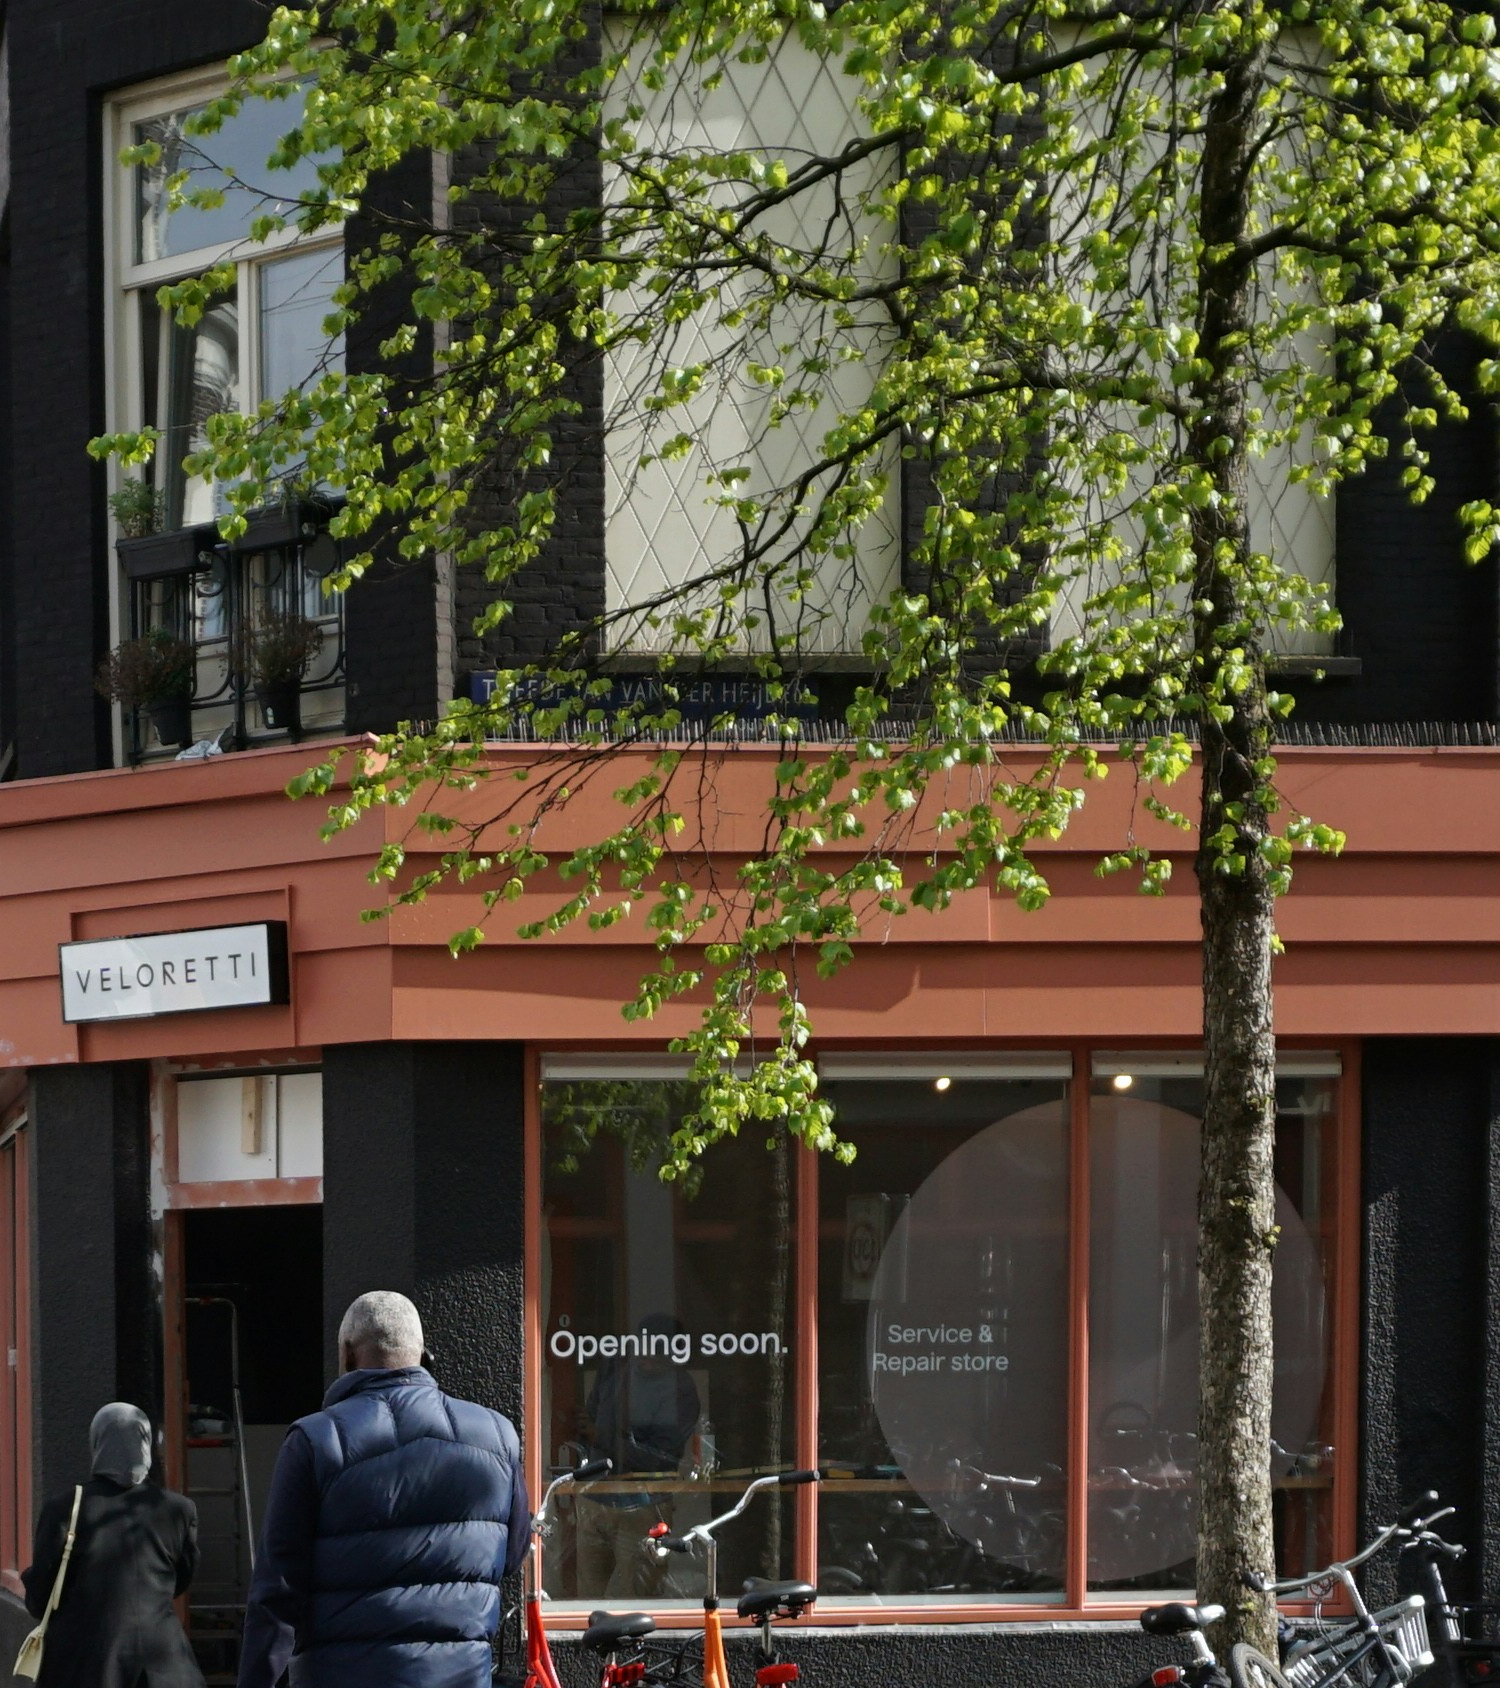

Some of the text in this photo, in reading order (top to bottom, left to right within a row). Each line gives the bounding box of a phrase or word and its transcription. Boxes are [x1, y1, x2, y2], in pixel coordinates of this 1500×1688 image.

[75, 951, 257, 996] VELORETTI
[550, 1327, 789, 1364] Opening soon.
[887, 1324, 994, 1344] Service &
[872, 1353, 1009, 1376] Repair store
